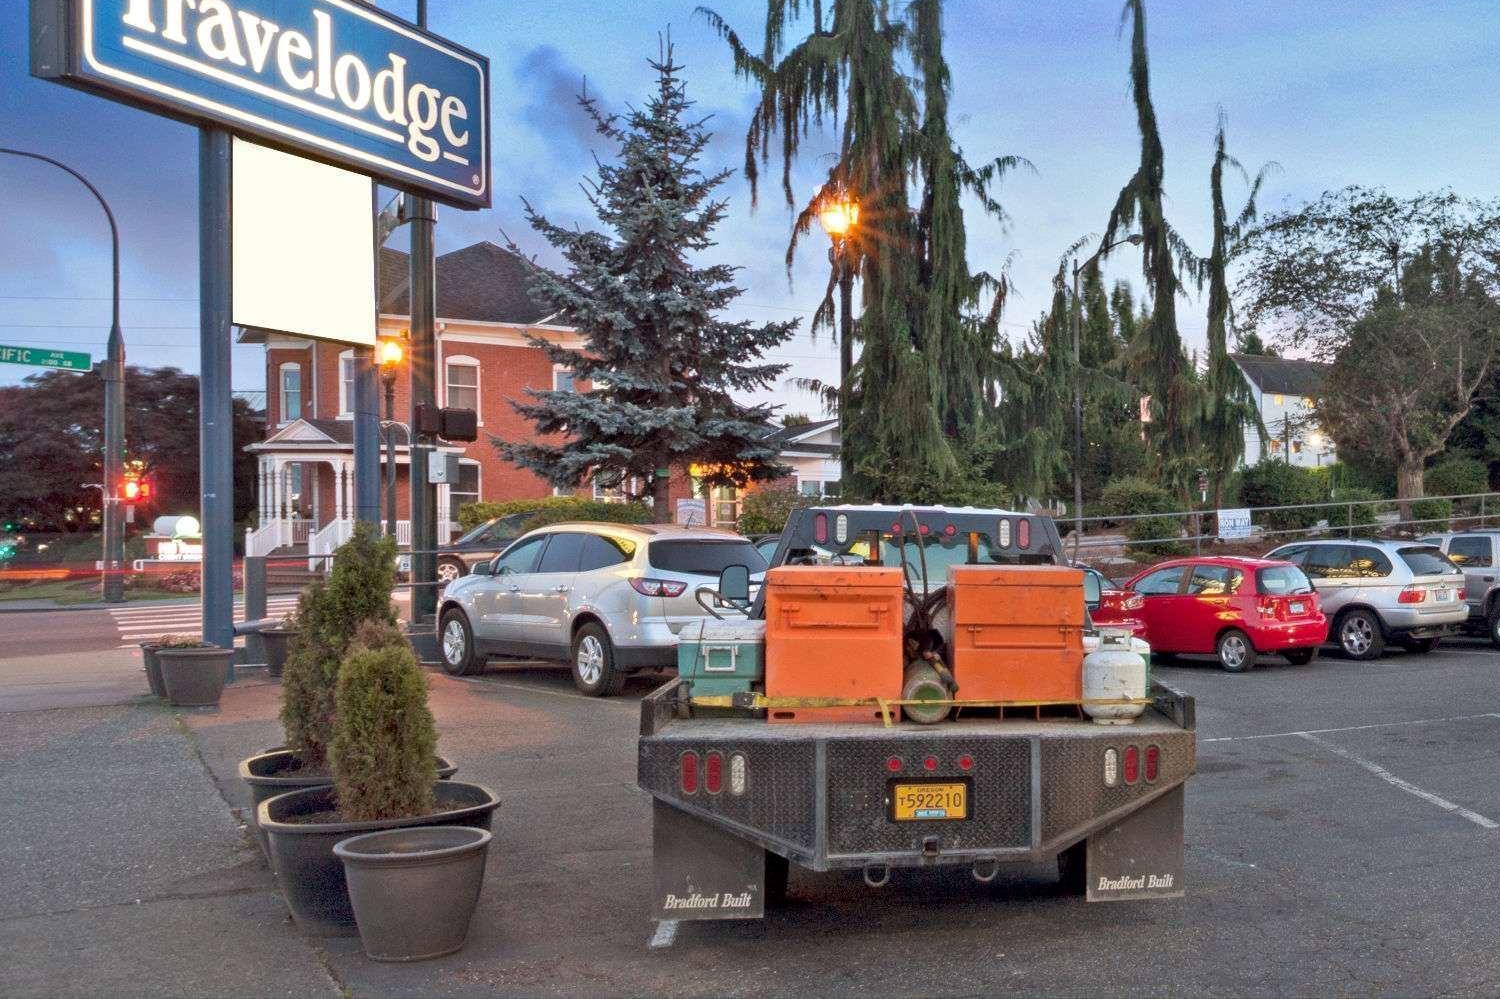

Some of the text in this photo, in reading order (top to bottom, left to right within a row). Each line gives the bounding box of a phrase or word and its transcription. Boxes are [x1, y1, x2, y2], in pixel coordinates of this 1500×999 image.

[0, 347, 32, 363] IFIC
[898, 792, 963, 809] T592210
[1097, 873, 1175, 891] Bradford Built
[663, 892, 752, 910] Bradford Built
